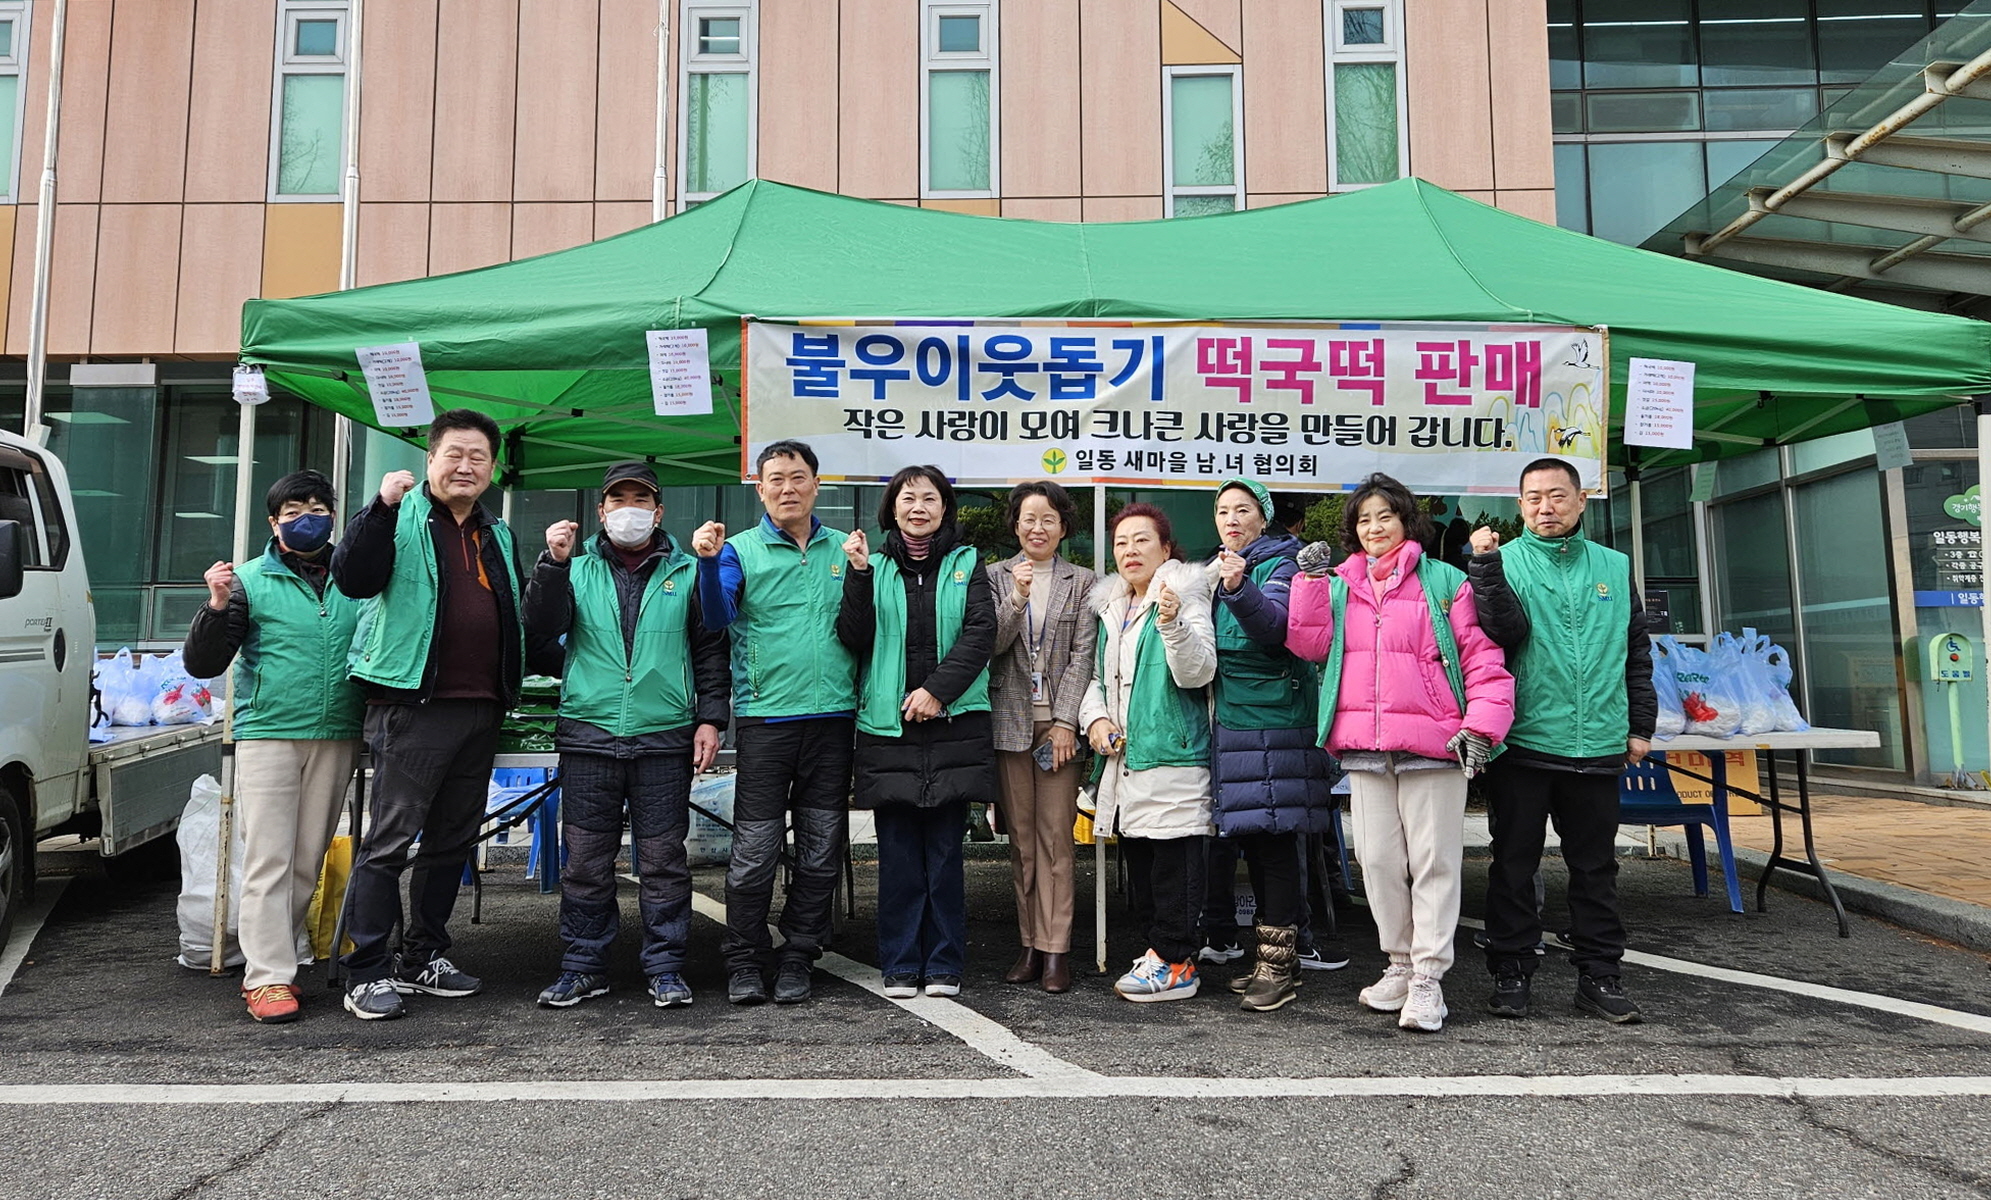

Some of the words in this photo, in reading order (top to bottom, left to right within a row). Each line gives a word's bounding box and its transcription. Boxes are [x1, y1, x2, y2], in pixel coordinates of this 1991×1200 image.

[786, 333, 1164, 401] 불우이웃돕기
[1197, 337, 1384, 405] 떡국떡
[1415, 340, 1541, 408] 판매
[843, 409, 905, 439] 작은
[915, 410, 1008, 441] 사랑이
[1019, 410, 1079, 440] 모여
[1091, 410, 1184, 442] 크나큰
[1194, 412, 1289, 445] 사랑을
[1301, 414, 1397, 447] 만들어
[1408, 416, 1512, 448] 갑니다.
[1076, 449, 1116, 471] 일동
[1124, 450, 1188, 473] 새마을
[1196, 452, 1243, 475] 남.녀
[1253, 454, 1317, 476] 협의회
[1952, 503, 1980, 513] 경기행
[1933, 531, 1981, 545] 일동행복
